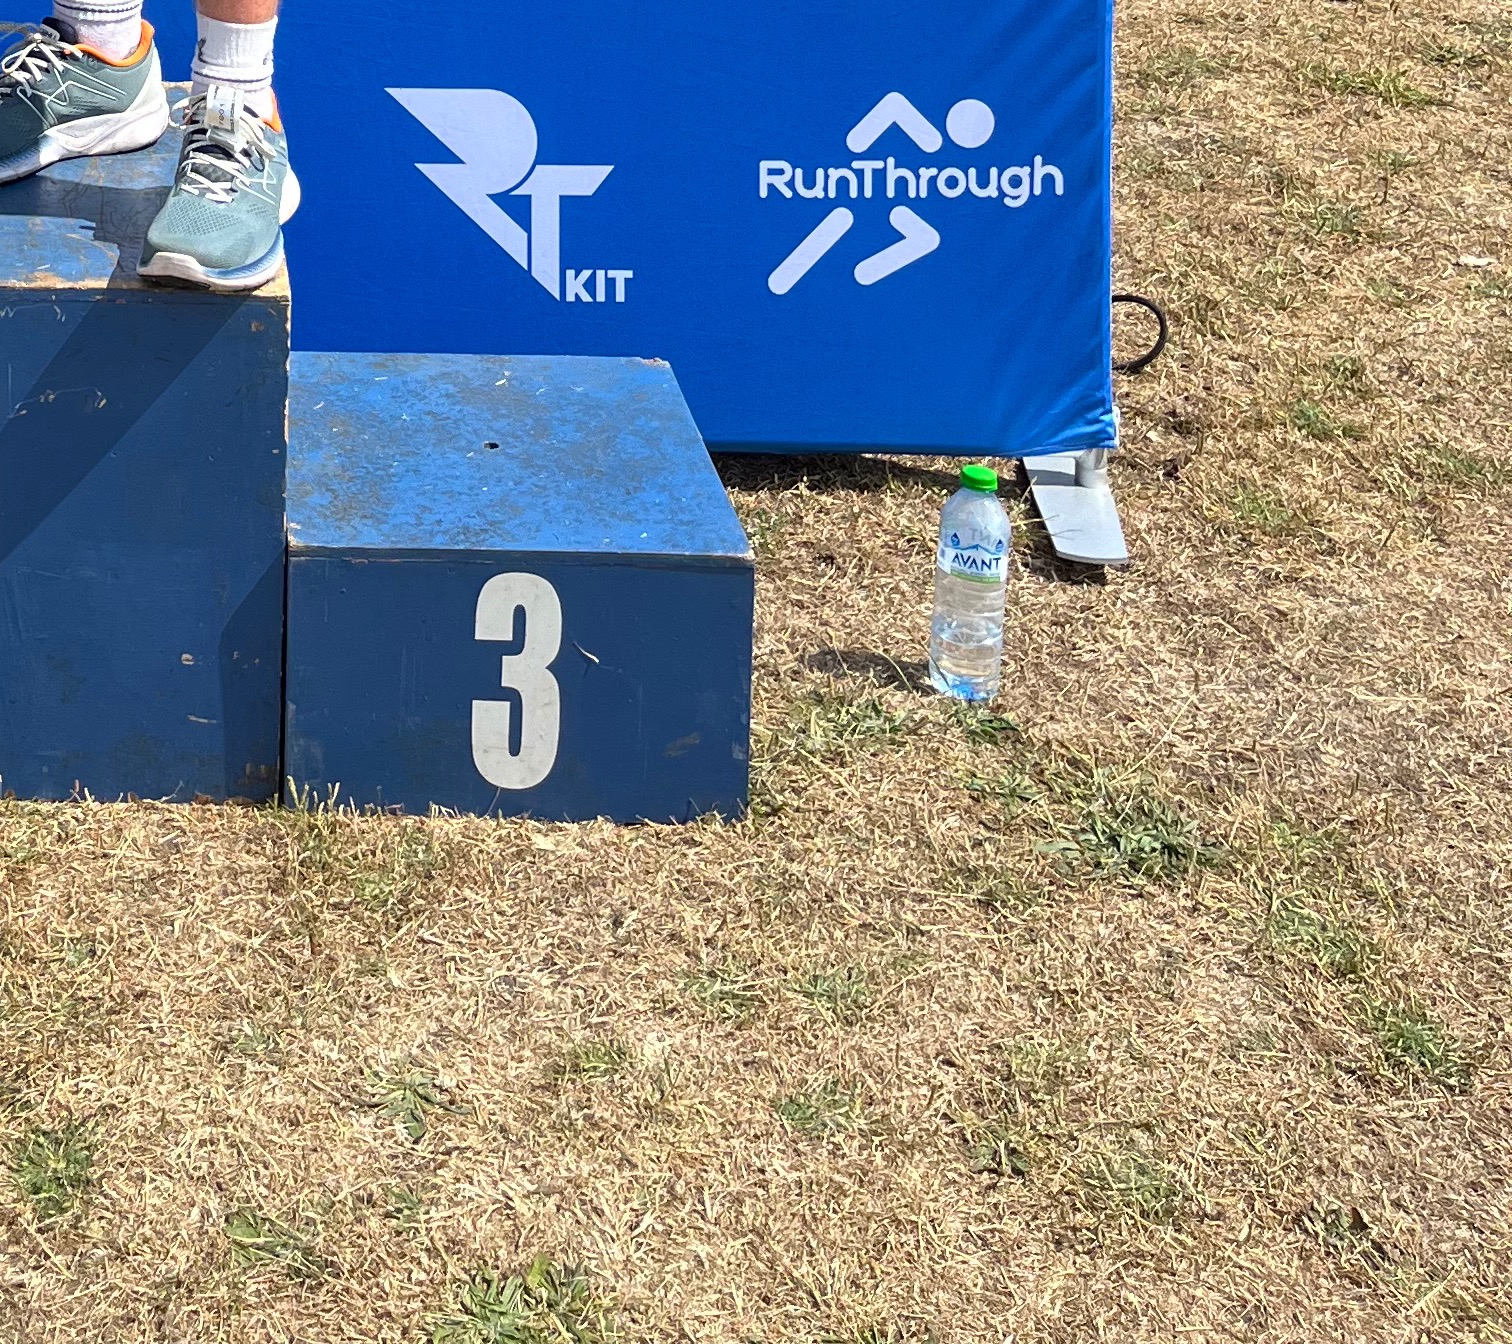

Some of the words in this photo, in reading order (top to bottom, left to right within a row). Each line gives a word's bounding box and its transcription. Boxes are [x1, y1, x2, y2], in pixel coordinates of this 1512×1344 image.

[760, 155, 1063, 207] RunThrough
[566, 269, 633, 302] KIT
[951, 552, 1001, 572] AVANT
[471, 572, 562, 790] 3
